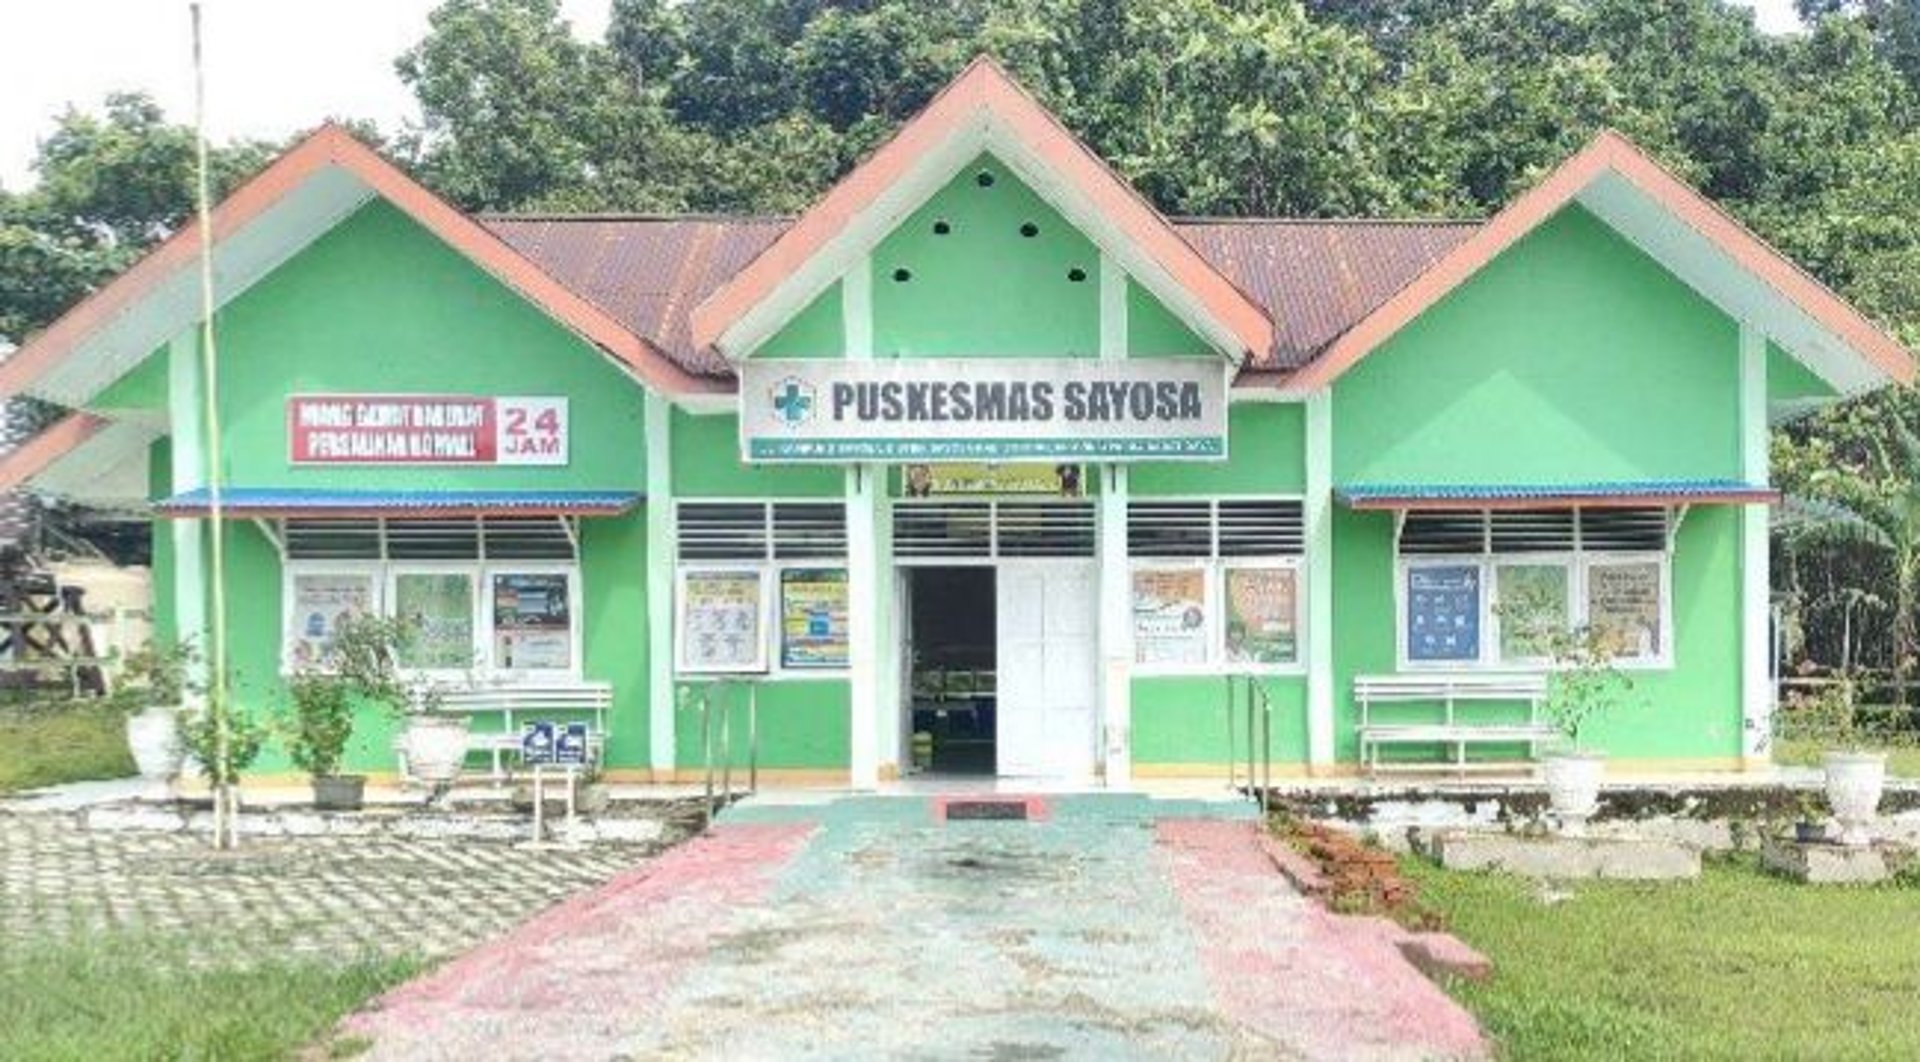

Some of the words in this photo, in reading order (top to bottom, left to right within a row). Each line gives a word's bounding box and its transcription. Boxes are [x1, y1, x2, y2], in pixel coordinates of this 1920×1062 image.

[833, 381, 1054, 421] PUSKESMAS
[1064, 381, 1201, 421] SAYOSA
[505, 407, 560, 436] 24
[505, 437, 561, 455] JAM
